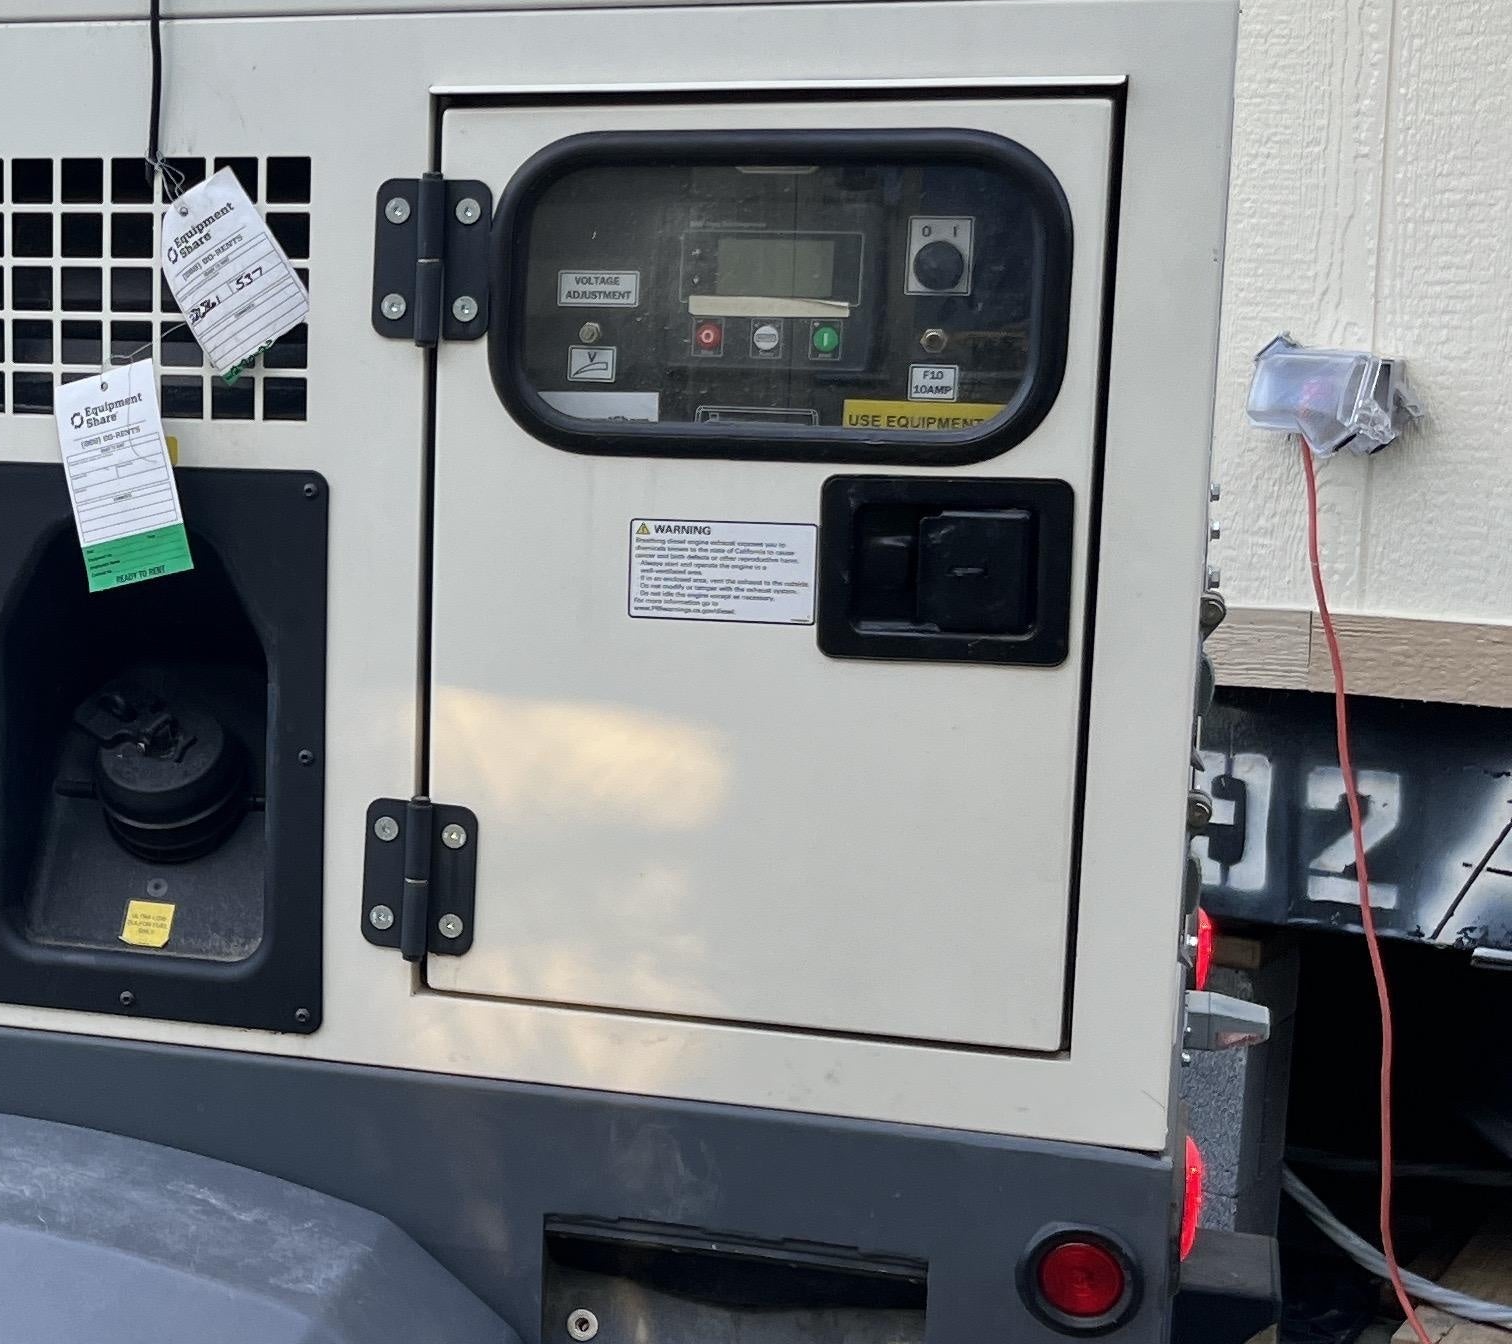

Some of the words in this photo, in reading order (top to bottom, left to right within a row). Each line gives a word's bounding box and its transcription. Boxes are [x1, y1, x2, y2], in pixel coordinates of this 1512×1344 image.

[173, 201, 235, 248] Equipment
[178, 231, 212, 260] Share
[574, 276, 621, 287] VOLTAGE
[565, 290, 632, 301] ADJUSTMENT
[587, 351, 598, 363] V
[922, 370, 944, 380] F10
[912, 385, 953, 395] 10AMP
[84, 391, 143, 418] Equipment
[86, 410, 119, 429] Share
[848, 414, 882, 427] USE
[654, 524, 712, 536] WARNING
